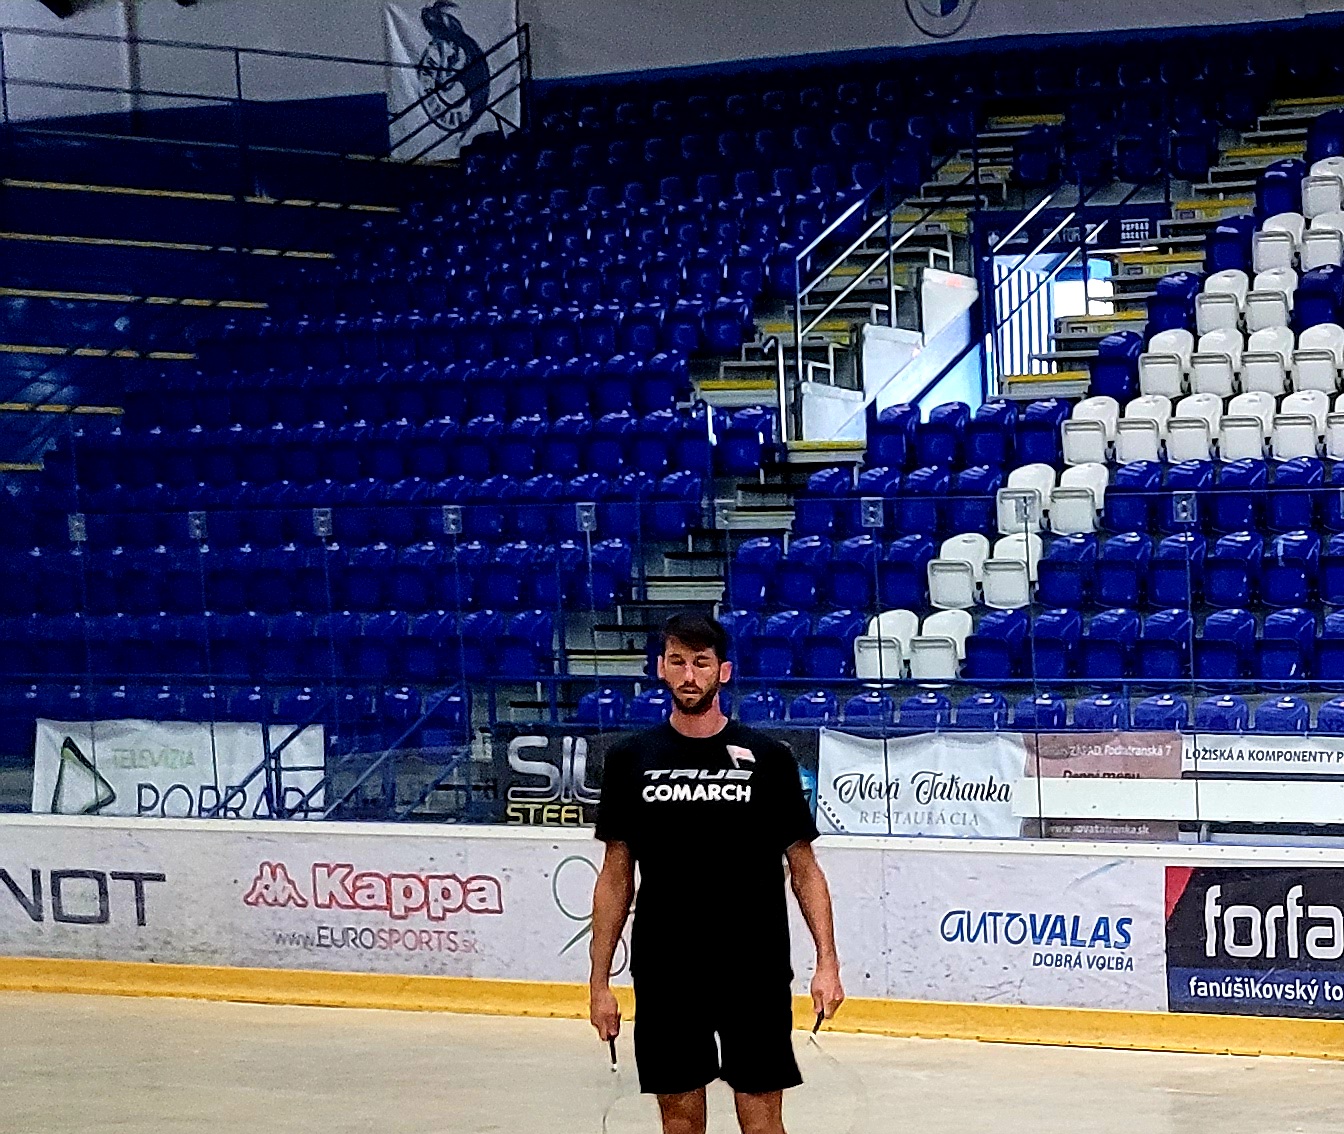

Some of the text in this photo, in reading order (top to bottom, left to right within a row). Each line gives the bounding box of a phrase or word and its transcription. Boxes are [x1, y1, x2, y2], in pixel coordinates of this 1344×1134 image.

[1236, 750, 1245, 762] A
[1247, 749, 1335, 764] KOMPONENTY
[643, 769, 753, 781] TRUE
[642, 783, 752, 803] COMARCH
[832, 770, 1013, 806] Nová Tatranka
[507, 803, 597, 827] STEEL
[312, 862, 504, 921] Kappa
[1032, 951, 1083, 969] DOBRÁ
[1188, 977, 1320, 1003] fanúšikovský
